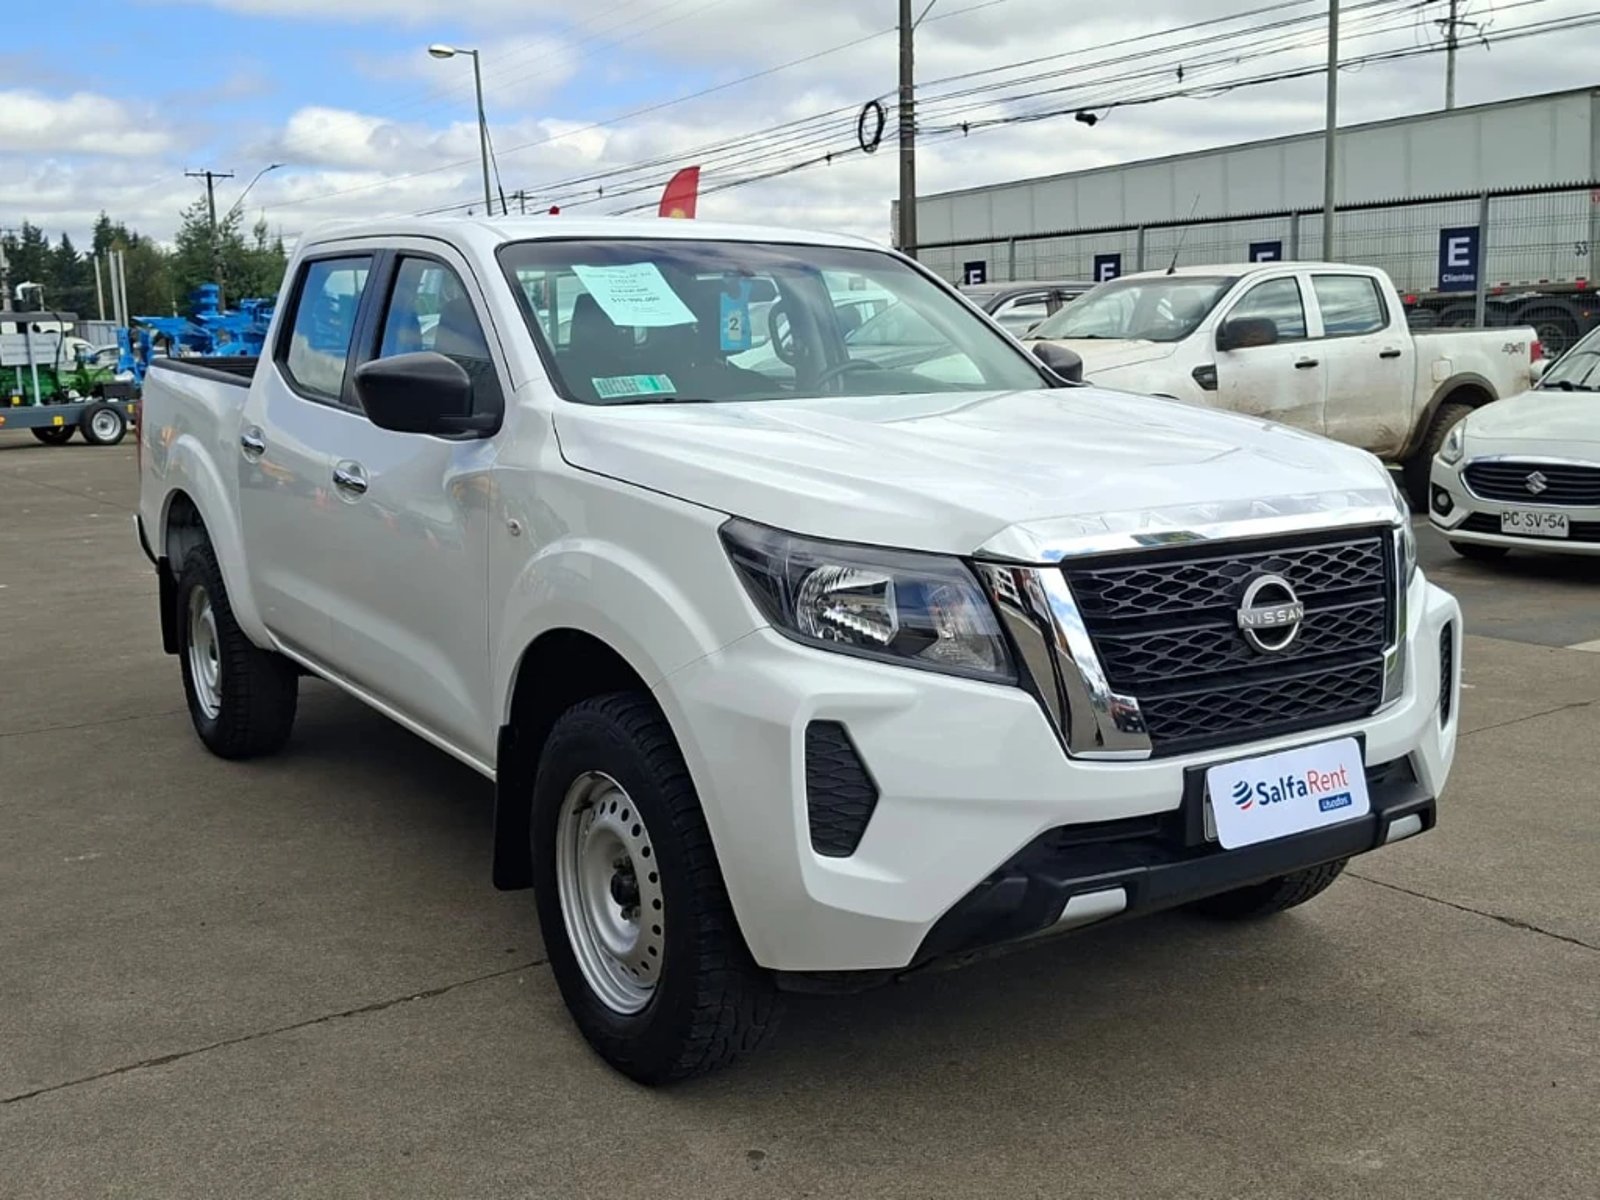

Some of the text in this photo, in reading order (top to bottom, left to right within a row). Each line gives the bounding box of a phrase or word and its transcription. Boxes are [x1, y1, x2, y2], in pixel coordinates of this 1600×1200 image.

[1448, 237, 1470, 266] E
[1442, 273, 1475, 283] Clientes
[729, 317, 740, 331] 2
[1239, 606, 1303, 625] NISSAN
[1256, 763, 1349, 806] SalfaRent
